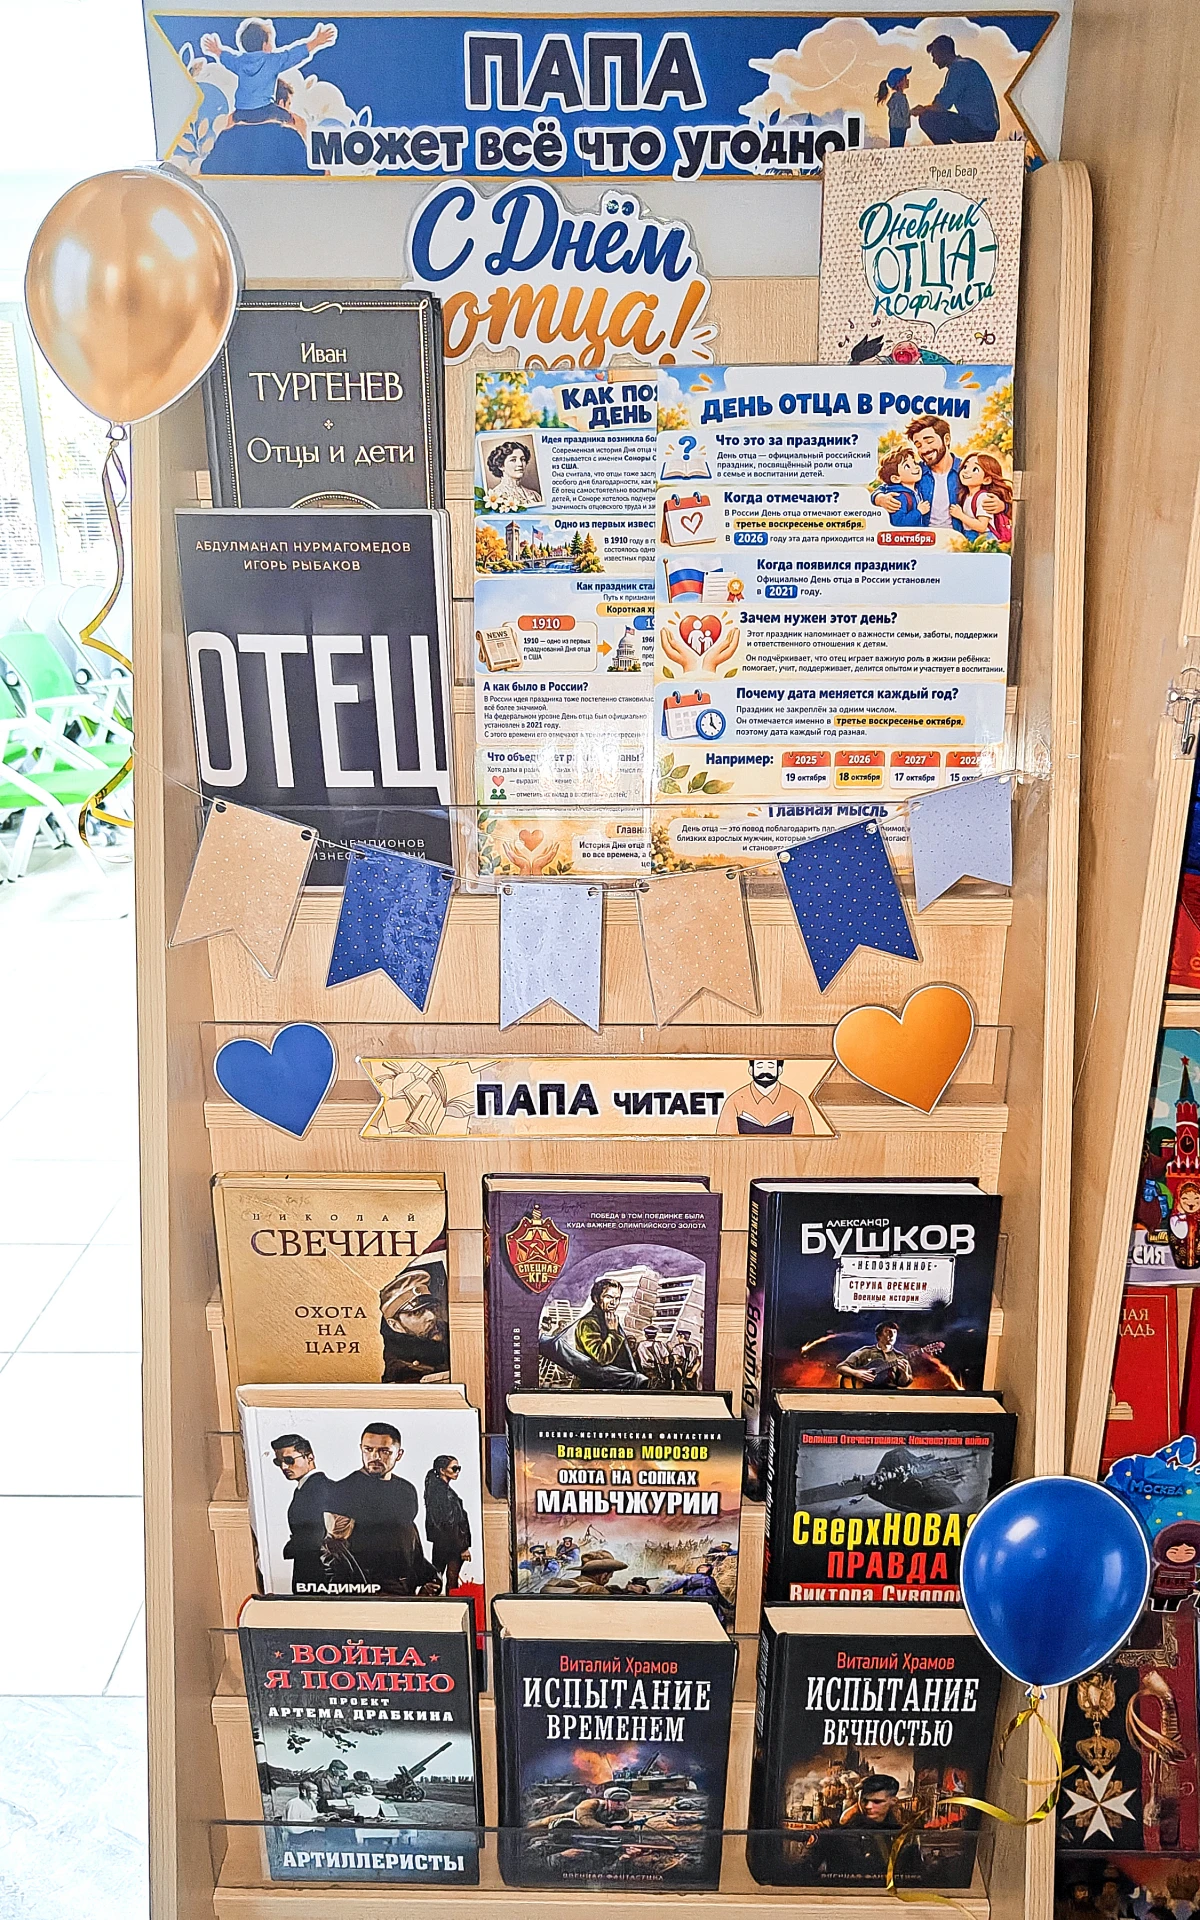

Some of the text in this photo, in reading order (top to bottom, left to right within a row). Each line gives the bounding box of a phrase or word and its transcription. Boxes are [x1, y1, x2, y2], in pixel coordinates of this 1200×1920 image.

[468, 35, 701, 110] ПАПА
[310, 117, 860, 179] может всё что угодно!
[955, 165, 978, 179] Беар
[858, 198, 987, 249] Дневник
[413, 185, 692, 282] С Днём
[873, 228, 998, 294] ОТЦА-
[872, 282, 995, 319] пофигиста
[444, 280, 706, 366] отца!
[300, 343, 348, 364] Иван
[249, 371, 404, 402] ТУРГЕНЕВ
[561, 386, 614, 412] КАК
[700, 391, 971, 425] ДЕНЬ ОТЦА В РОССИИ
[587, 404, 653, 430] ДЕНЬ
[541, 435, 563, 445] Идея
[563, 436, 606, 446] праздника
[715, 433, 859, 449] Что это за праздник?
[246, 437, 416, 466] Отцы и дети
[716, 461, 756, 471] праздник,
[757, 460, 813, 470] посвящённый
[813, 462, 833, 471] роли
[723, 491, 840, 505] Когда отмечают?
[195, 540, 412, 554] АБДУЛМАНАП НУРМАГОМЕДОВ
[724, 534, 731, 542] В
[737, 533, 764, 544] 2026
[769, 536, 788, 544] году
[801, 536, 820, 544] дата
[820, 536, 865, 544] приходится
[880, 533, 893, 543] 18
[893, 533, 937, 546] октября.
[243, 559, 361, 571] ИГОРЬ РЫБАКОВ
[756, 558, 918, 573] Когда появился праздник?
[756, 586, 822, 598] в 2021 году.
[606, 605, 646, 616] Короткая
[529, 617, 563, 632] 1910
[739, 611, 898, 627] Зачем нужен этот день?
[486, 630, 510, 641] NEWS
[483, 680, 589, 692] А как было в России?
[736, 686, 959, 702] Почему дата меняется каждый год?
[188, 632, 449, 805] ОТЕЦ
[705, 752, 774, 768] Например:
[795, 755, 818, 765] 2025
[848, 754, 872, 765] 2026
[904, 754, 927, 765] 2027
[785, 772, 827, 784] 19 октября
[838, 771, 881, 783] 18 октября
[477, 1084, 724, 1116] ПАПА ЧИТАЕТ
[252, 1212, 417, 1223] НИКОЛАЙ
[250, 1228, 419, 1258] СВЕЧИН
[750, 1200, 760, 1287] СТРУНА ВРЕМЕНИ
[801, 1221, 975, 1259] БУШКОВ
[518, 1264, 558, 1274] СПЕЦНАЗ
[528, 1273, 548, 1283] КГБ
[849, 1281, 928, 1291] СТРУНА ВРЕМЕНИ
[853, 1293, 920, 1303] Военные истории
[294, 1305, 367, 1319] ОХОТА
[318, 1323, 346, 1336] НА
[305, 1341, 361, 1355] ЦАРЯ
[743, 1303, 761, 1408] БУШКОВ
[802, 1434, 838, 1444] Великая
[557, 1445, 708, 1460] Владислав МОРОЗОВ
[559, 1470, 696, 1485] ОХОТА НА СОПКАХ
[537, 1490, 719, 1514] МАНЬЧЖУРИИ
[793, 1511, 977, 1550] СверхНОВА
[827, 1552, 948, 1583] ПРАВДА
[296, 1583, 381, 1594] ВЛАДИМИР
[790, 1584, 961, 1602] Виктора Суворо
[290, 1639, 426, 1666] ВОЙНА
[559, 1655, 679, 1676] Виталий Храмов
[836, 1652, 955, 1674] Виталий Храмов
[264, 1670, 455, 1693] Я ПОМНЮ
[329, 1697, 390, 1706] ПРОЕКТ
[522, 1677, 711, 1711] ИСПЫТАНИЕ
[805, 1677, 979, 1712] ИСПЫТАНИЕ
[268, 1706, 453, 1722] АРТЕМА ДРАБКИНА
[546, 1714, 685, 1742] ВРЕМЕНЕМ
[822, 1719, 954, 1747] ВЕЧНОСТЬЮ
[282, 1851, 465, 1872] АРТИЛЛЕРИСТЫ
